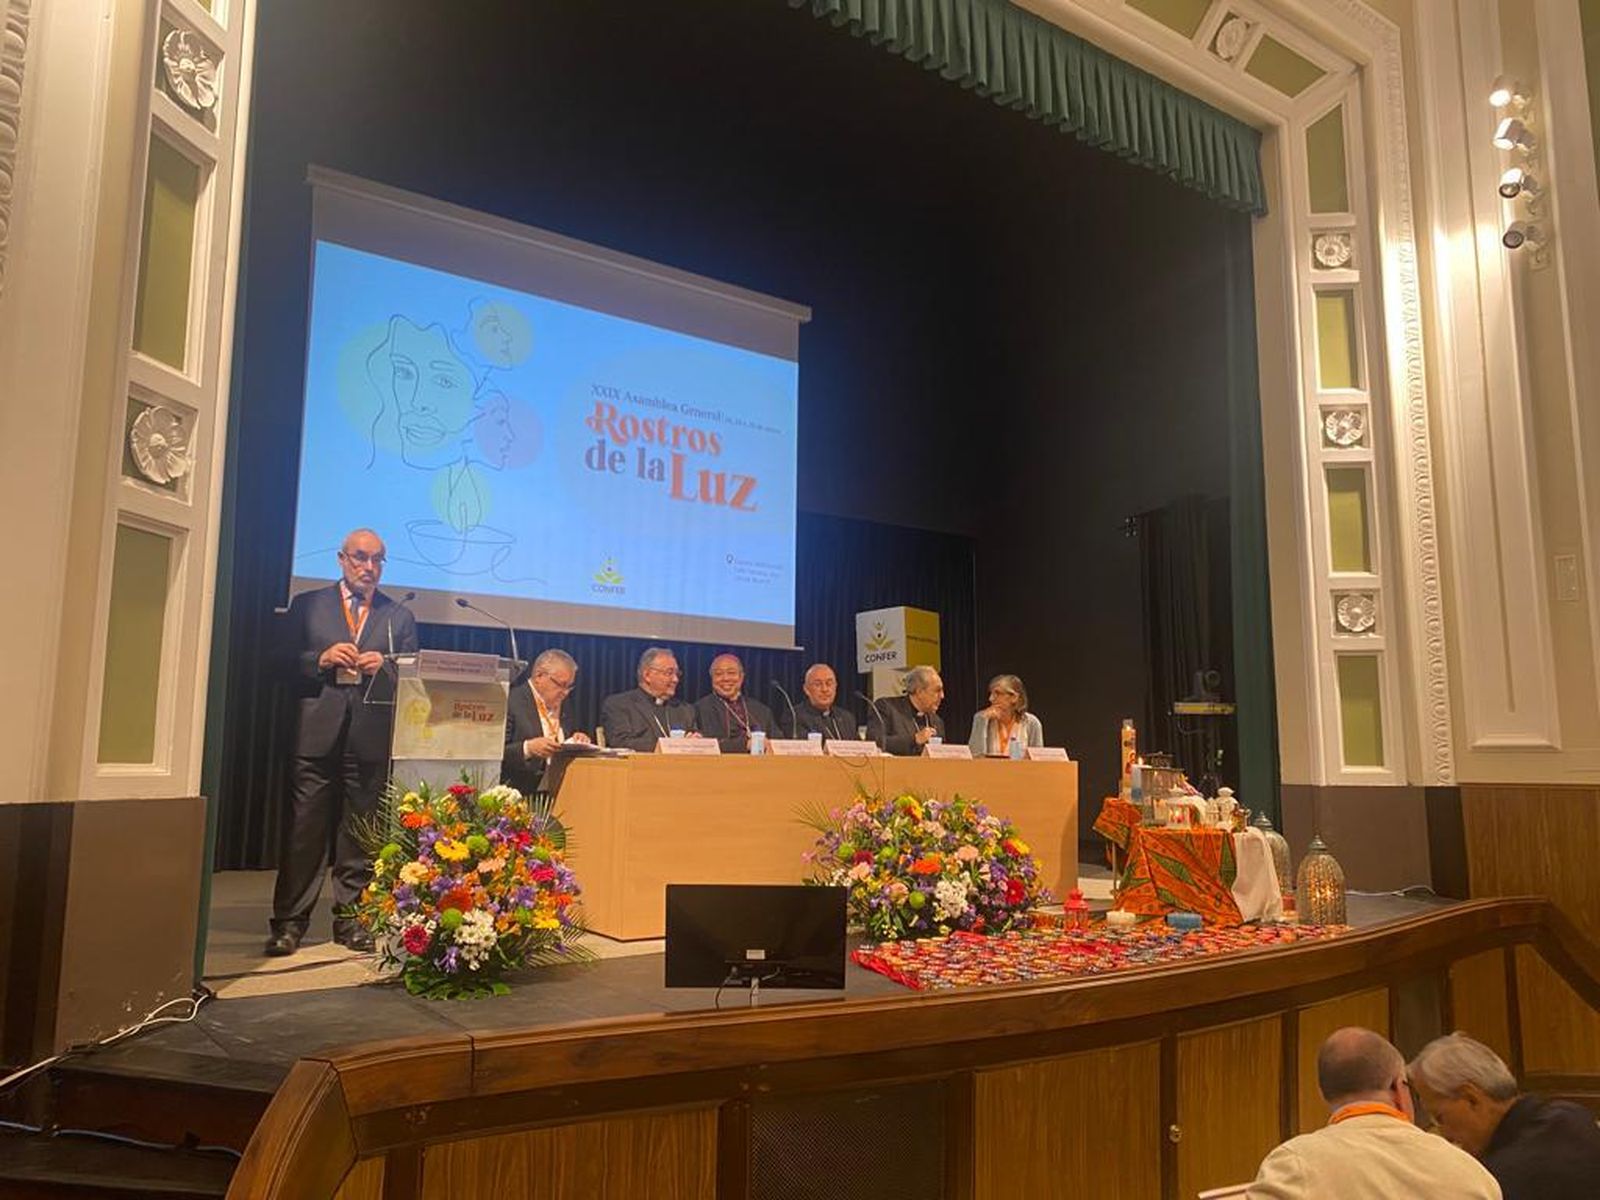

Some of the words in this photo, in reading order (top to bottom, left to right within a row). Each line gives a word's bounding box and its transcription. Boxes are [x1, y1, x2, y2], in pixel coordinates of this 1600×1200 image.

[591, 384, 620, 400] XXIX
[624, 391, 678, 412] Asamblea
[681, 403, 721, 422] General
[585, 400, 722, 456] Rostros
[585, 439, 626, 474] de
[637, 447, 665, 482] la
[671, 453, 759, 512] Luz
[864, 651, 897, 664] CONFER
[472, 711, 494, 722] Luz
